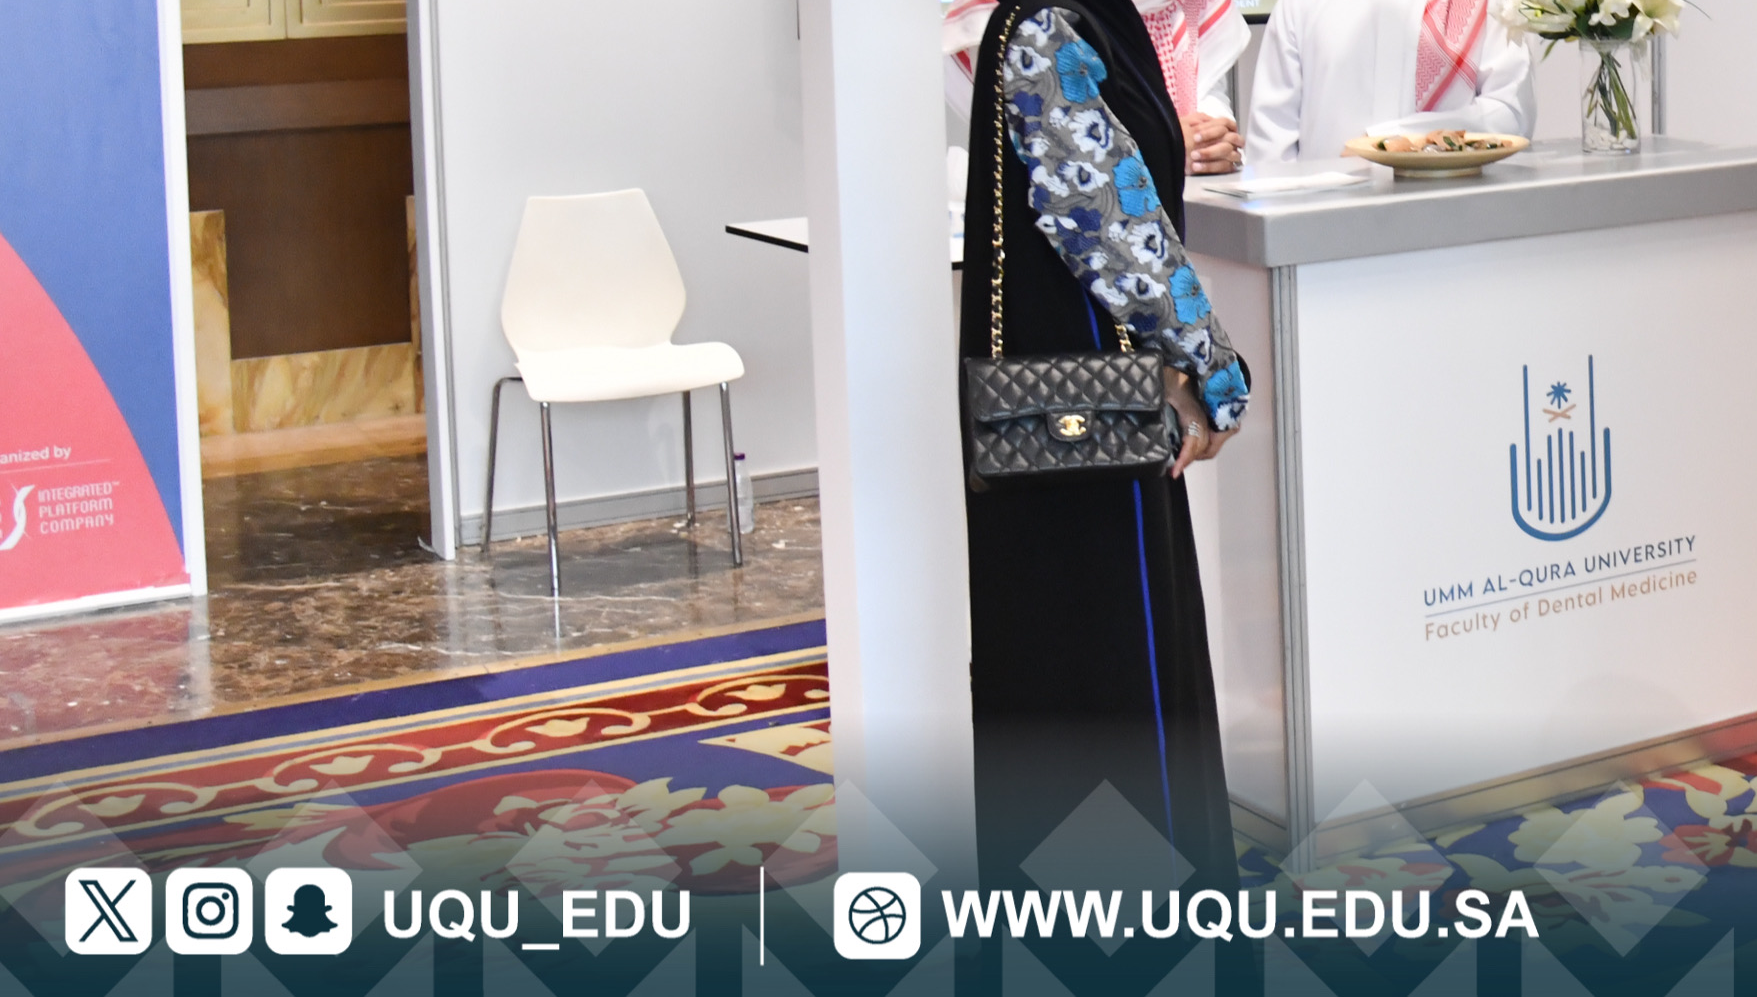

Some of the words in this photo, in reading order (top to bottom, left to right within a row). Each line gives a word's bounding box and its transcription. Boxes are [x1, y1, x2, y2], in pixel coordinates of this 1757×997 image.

[0, 446, 50, 465] anized
[53, 444, 72, 460] by
[39, 498, 114, 519] PLATFORM
[40, 514, 115, 535] COMPANY
[1424, 581, 1474, 607] UMM
[1483, 560, 1576, 595] AL-QURA
[1584, 535, 1697, 574] UNIVERSITY
[1425, 612, 1501, 642] Faculty
[1509, 602, 1530, 623] of
[1538, 586, 1603, 618] Dental
[1610, 569, 1698, 601] Medicine
